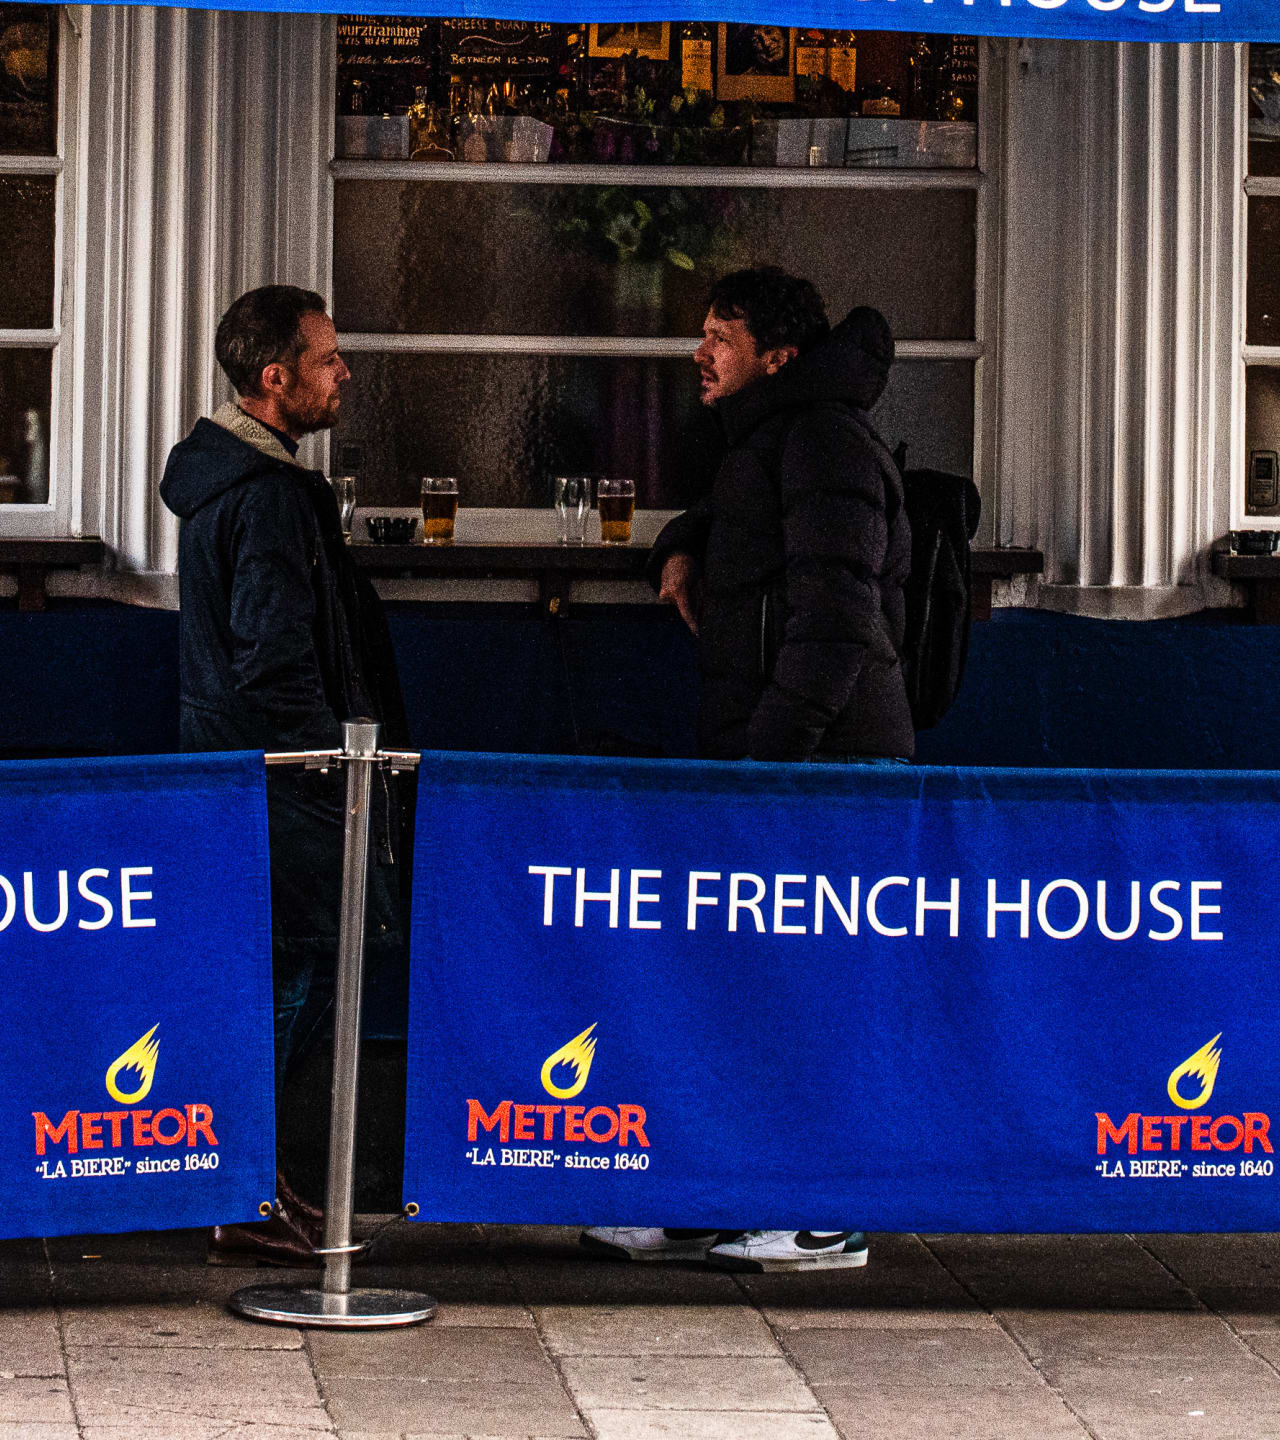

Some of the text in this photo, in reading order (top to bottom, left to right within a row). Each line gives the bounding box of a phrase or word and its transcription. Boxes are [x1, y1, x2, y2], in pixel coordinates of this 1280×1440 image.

[450, 53, 501, 65] BETWEEN
[528, 865, 1226, 943] THE FRENCH HOUSE
[32, 1103, 219, 1155] METEOR
[466, 1099, 651, 1147] METEOR
[1094, 1112, 1275, 1155] METEOR
[136, 1156, 180, 1174] since
[184, 1152, 220, 1170] 1640
[564, 1151, 610, 1169] since
[613, 1153, 650, 1171] 1640
[1191, 1161, 1236, 1177] since
[1238, 1160, 1274, 1177] 1640
